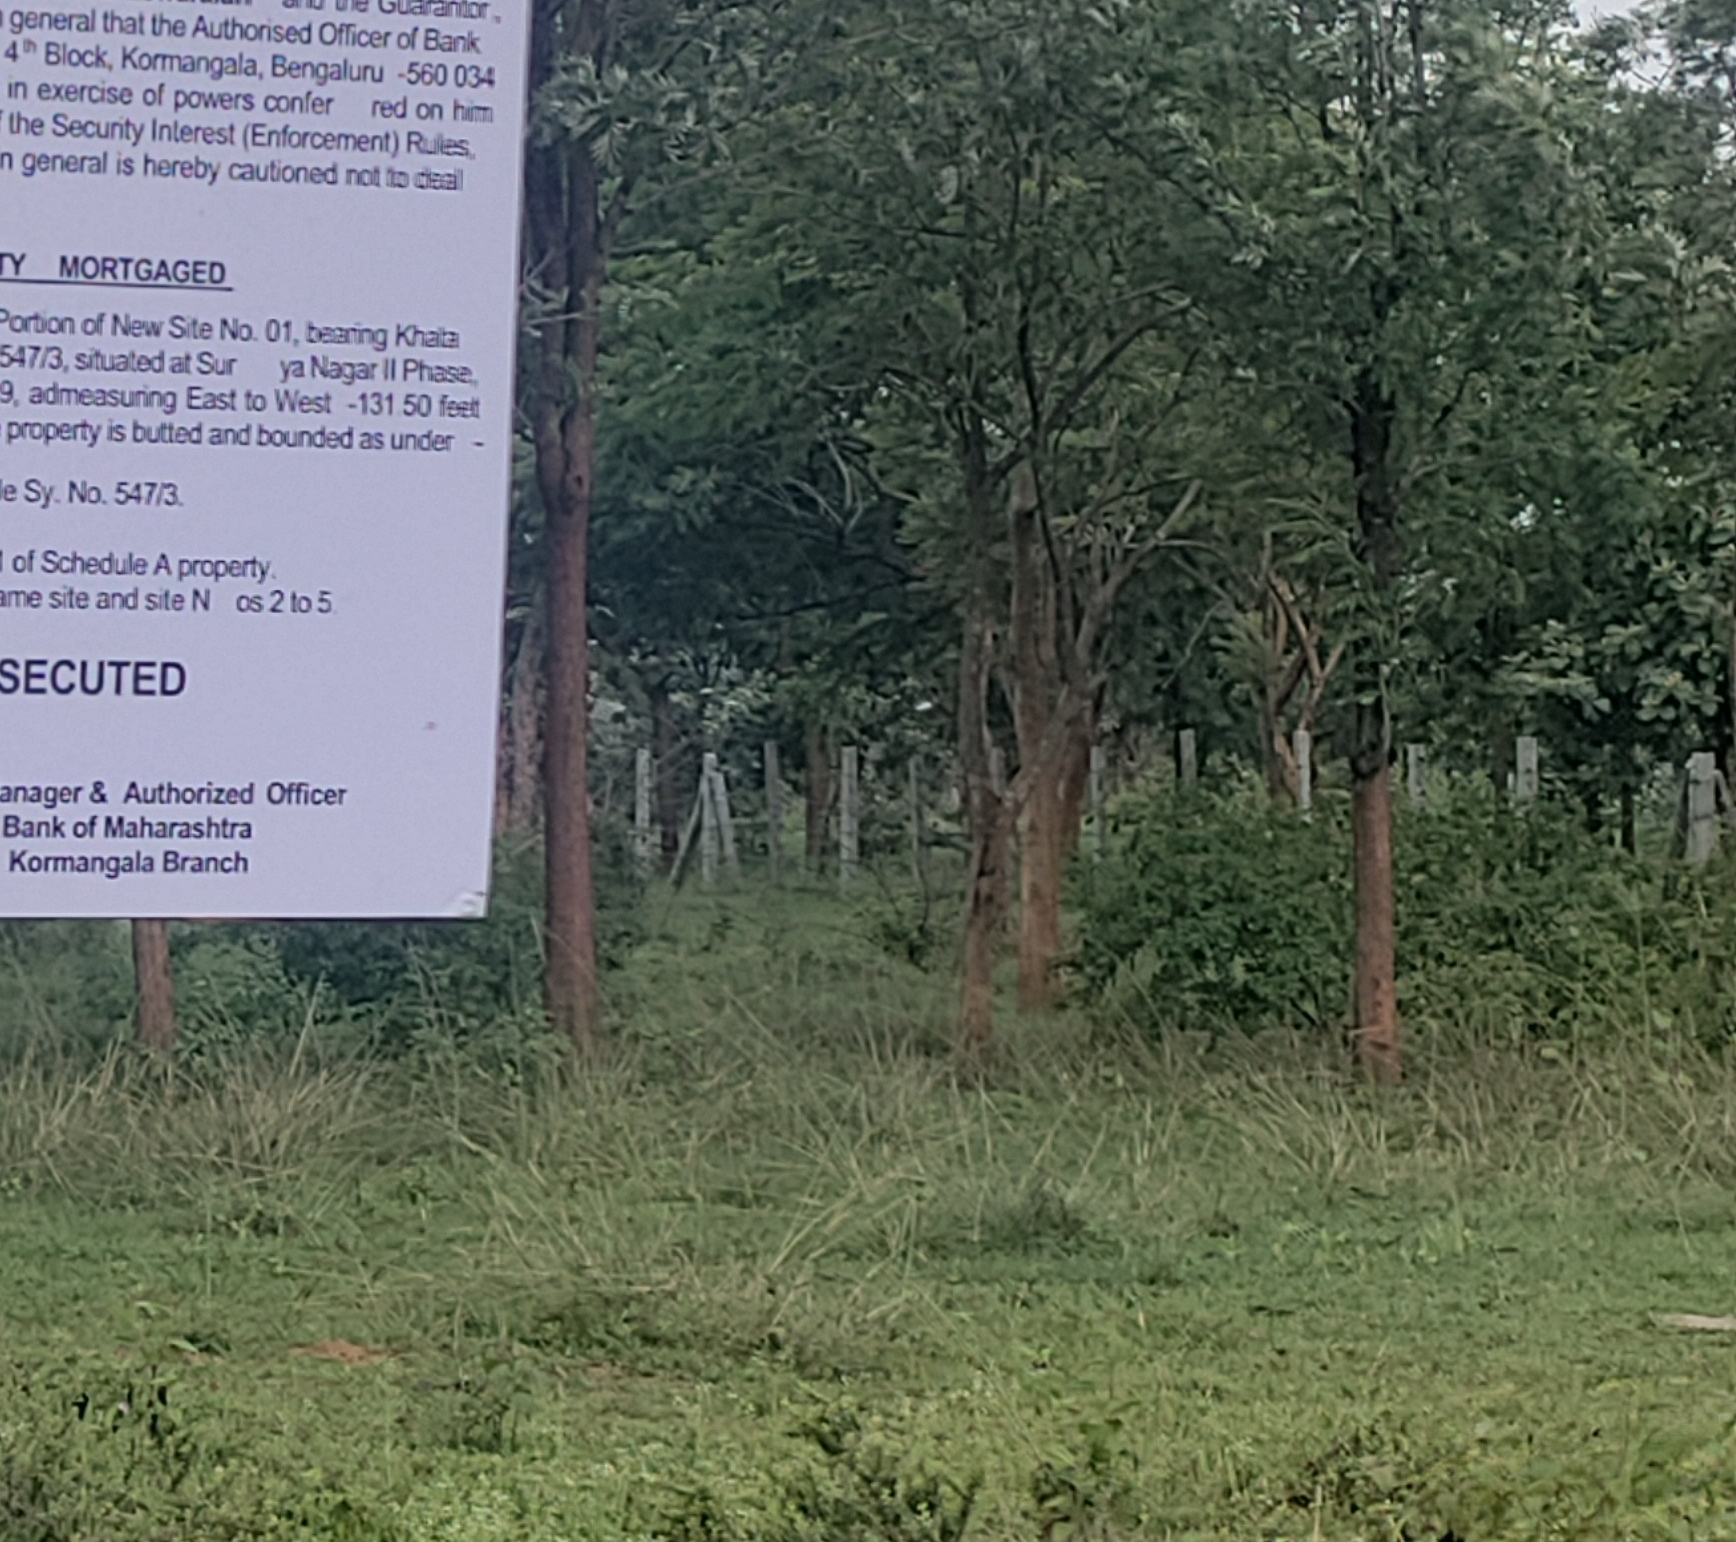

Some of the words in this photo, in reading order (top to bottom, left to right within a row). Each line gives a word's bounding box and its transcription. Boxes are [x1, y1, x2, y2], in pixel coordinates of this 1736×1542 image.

[9, 7, 98, 35] general
[191, 14, 314, 47] Authorised
[318, 21, 394, 50] Officer
[44, 41, 114, 73] Block,
[120, 45, 265, 82] Kormangala,
[270, 53, 386, 87] Bengaluru
[36, 80, 135, 107] exercise
[173, 88, 257, 113] powers
[51, 112, 147, 147] Security
[151, 117, 237, 147] Interest
[242, 122, 401, 159] (Enforcement)
[21, 150, 110, 178] general
[142, 151, 222, 186] hereby
[227, 159, 340, 187] cautioned
[58, 254, 228, 286] MORTGAGED
[74, 347, 167, 375] situated
[309, 354, 380, 386] Nagar
[28, 381, 179, 415] admeasuring
[5, 418, 104, 447] property
[131, 418, 205, 446] butted
[255, 423, 355, 451] bounded
[390, 429, 456, 453] under
[67, 479, 110, 507] No.
[40, 549, 150, 577] Schedule
[48, 583, 92, 611] site
[144, 587, 187, 613] site
[88, 780, 110, 806] &
[122, 780, 257, 807] Authorized
[266, 781, 349, 807] Officer
[2, 814, 67, 840] Bank
[72, 814, 100, 840] of
[103, 815, 254, 841] Maharashtra
[8, 848, 156, 881] Kormangala
[161, 849, 250, 875] Branch
